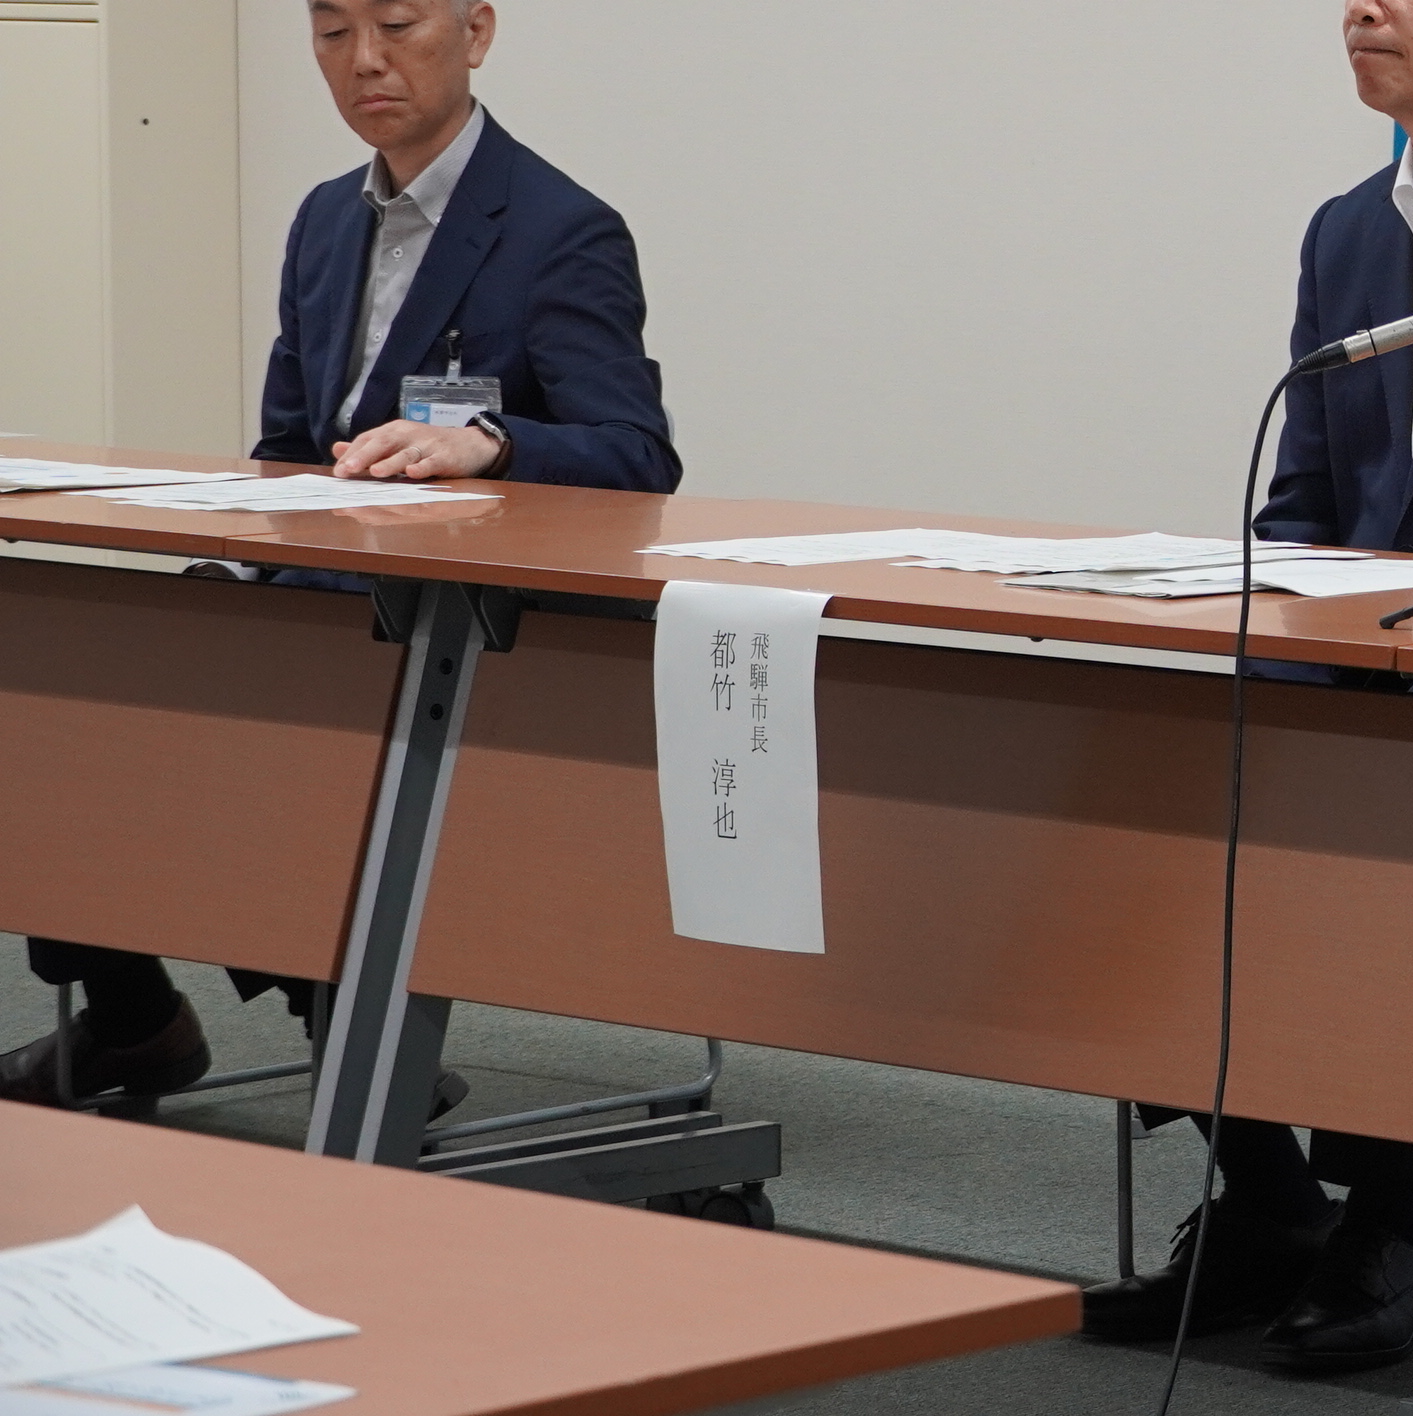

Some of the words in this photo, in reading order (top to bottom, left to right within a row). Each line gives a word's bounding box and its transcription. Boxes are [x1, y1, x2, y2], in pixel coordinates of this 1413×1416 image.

[709, 628, 737, 712] 都竹
[749, 631, 770, 754] 飛騨市長
[711, 757, 738, 840] 淳也
